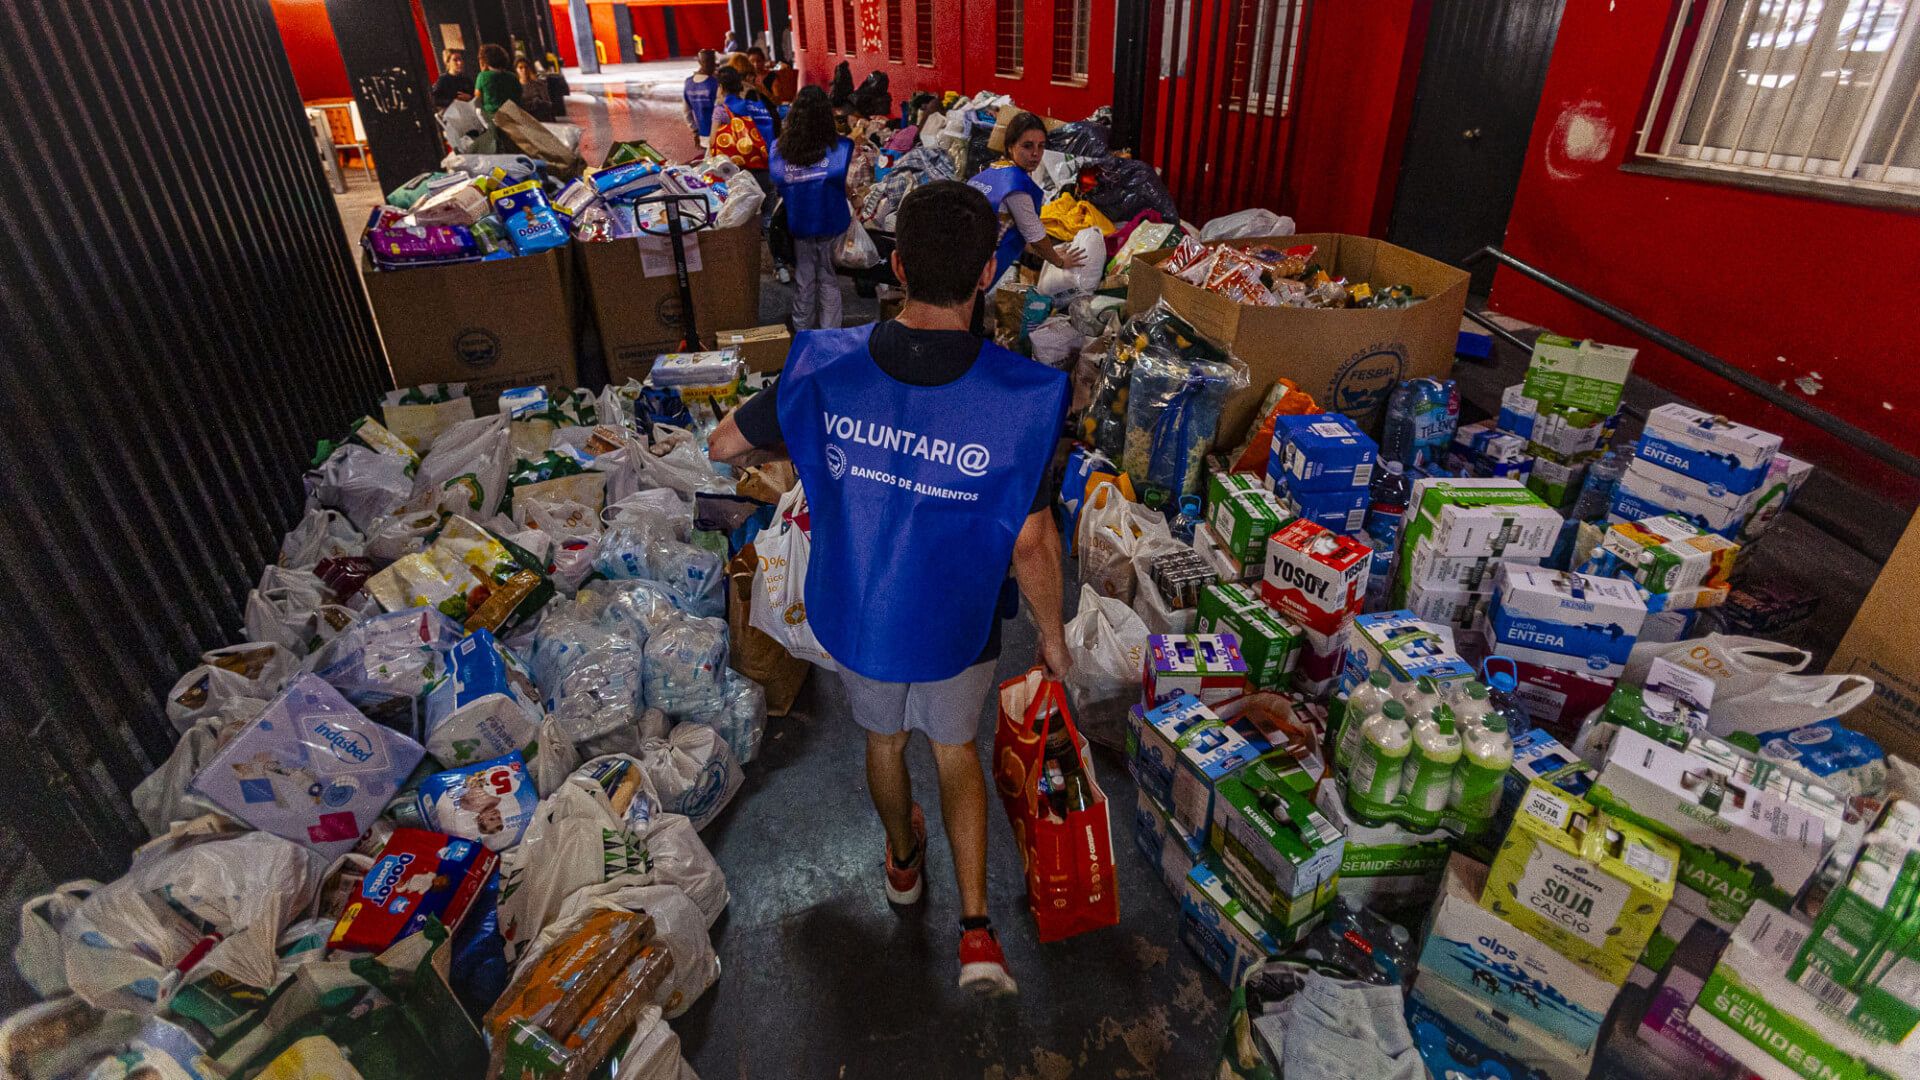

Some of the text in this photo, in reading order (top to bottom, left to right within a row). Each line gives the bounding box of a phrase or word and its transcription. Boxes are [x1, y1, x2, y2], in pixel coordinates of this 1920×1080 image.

[518, 221, 553, 238] DODOT
[1350, 366, 1395, 381] FESBAL
[823, 411, 990, 477] VOLUNTARI@
[1643, 447, 1690, 470] ENTERA
[850, 465, 979, 501] BANCOS DE ALIMENTOS
[1618, 502, 1649, 520] ENTE
[1508, 628, 1565, 648] ENTERA
[1511, 620, 1537, 632] Leche
[314, 722, 374, 762] indasbed
[490, 770, 512, 795] 5
[1532, 799, 1559, 820] SOJA
[369, 860, 393, 893] pants
[373, 852, 416, 907] DODOT
[1553, 863, 1604, 894] consum
[1541, 877, 1595, 919] SOJA
[1530, 895, 1591, 934] CALCIO
[1478, 935, 1518, 961] alps
